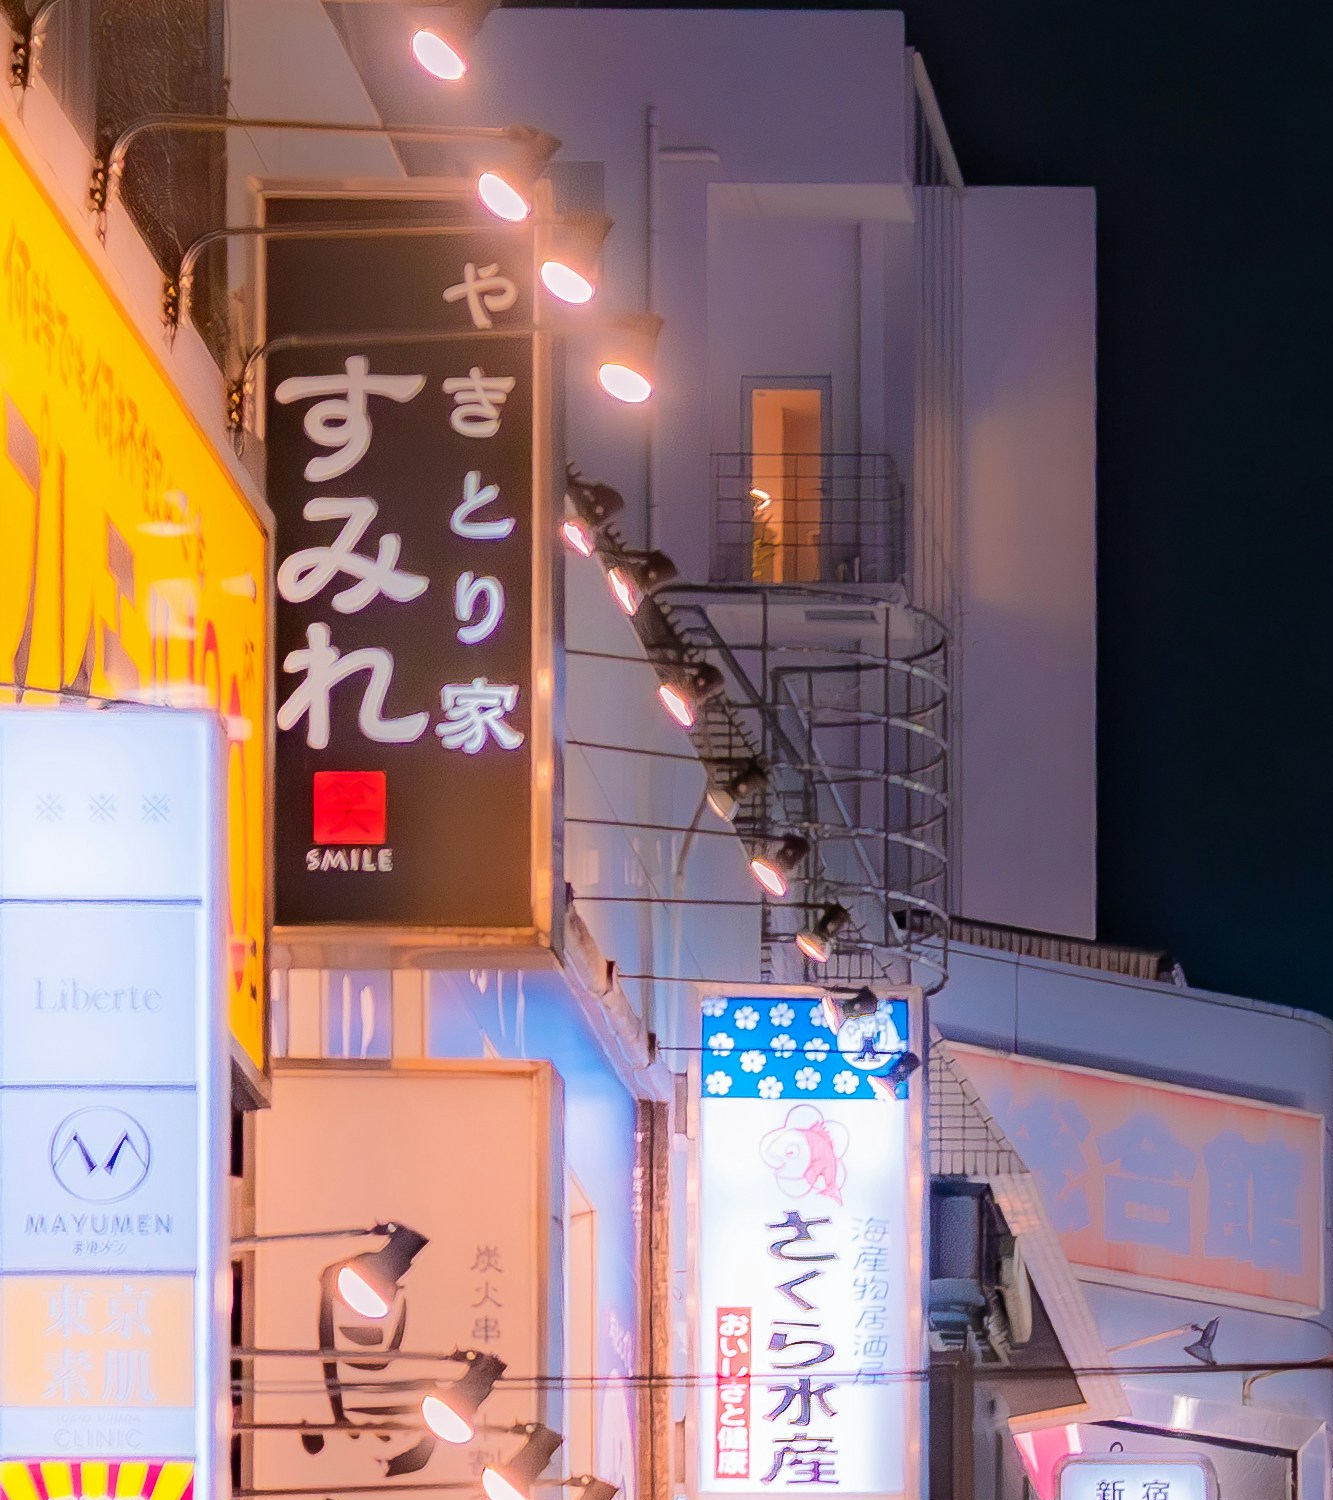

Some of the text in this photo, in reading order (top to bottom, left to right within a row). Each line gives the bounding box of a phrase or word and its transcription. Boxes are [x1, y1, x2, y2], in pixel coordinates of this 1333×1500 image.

[275, 355, 430, 750] すみれ
[442, 262, 526, 755] やきとり家
[306, 848, 393, 873] SMILE
[25, 1213, 173, 1235] MAYUMEN
[41, 1282, 154, 1340] 東京
[762, 1210, 840, 1487] さくら水産
[850, 1217, 889, 1387] 海産物居酒屋
[41, 1348, 157, 1403] 素肌
[718, 1313, 750, 1476] おいしさと健康
[54, 1428, 144, 1450] CLINIC
